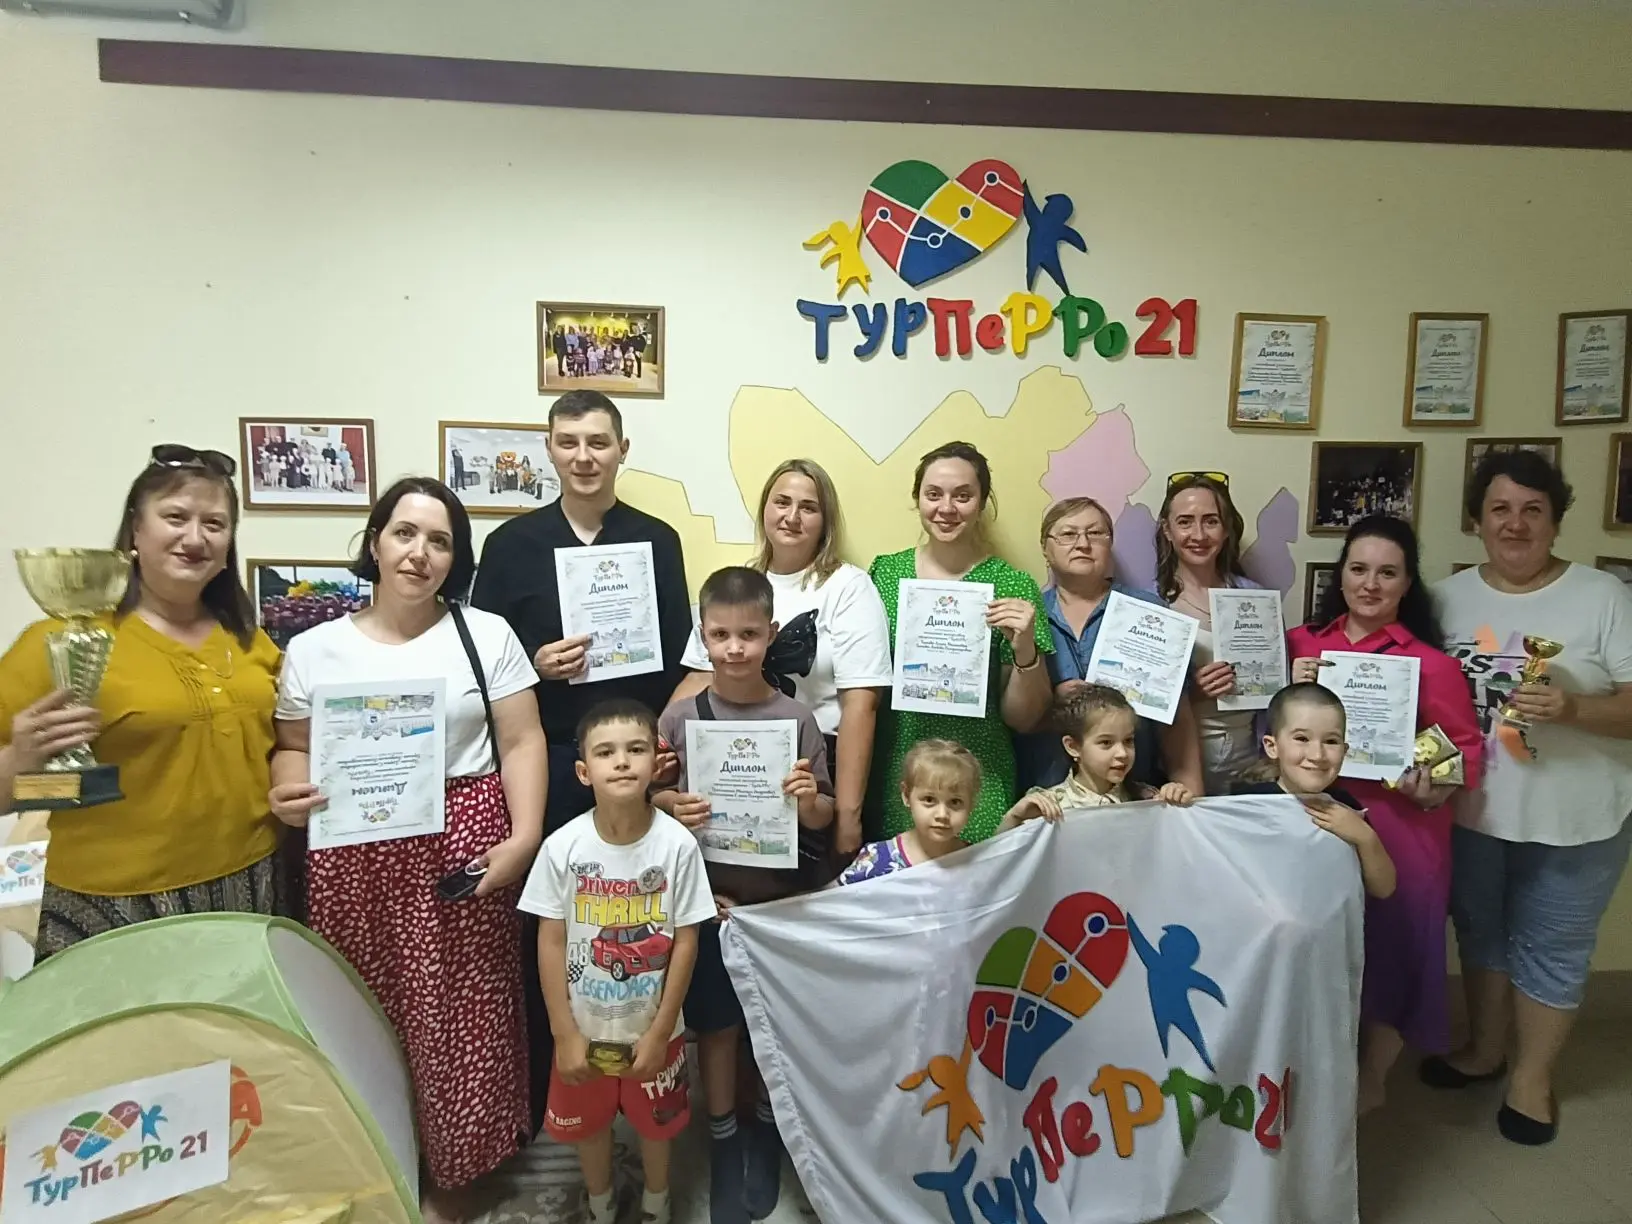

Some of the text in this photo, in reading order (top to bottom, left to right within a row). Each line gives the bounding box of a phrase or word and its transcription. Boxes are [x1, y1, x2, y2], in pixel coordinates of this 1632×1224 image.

[588, 582, 629, 595] Диплом
[924, 615, 965, 628] Диплом
[1233, 619, 1264, 630] Диплом
[1127, 625, 1167, 645] Диплом
[1343, 678, 1387, 691] Диплом
[719, 760, 767, 774] Диплом
[351, 780, 408, 796] Диплом
[574, 891, 668, 927] THRILL
[567, 941, 590, 966] 48
[576, 974, 660, 1003] LEGENDARY
